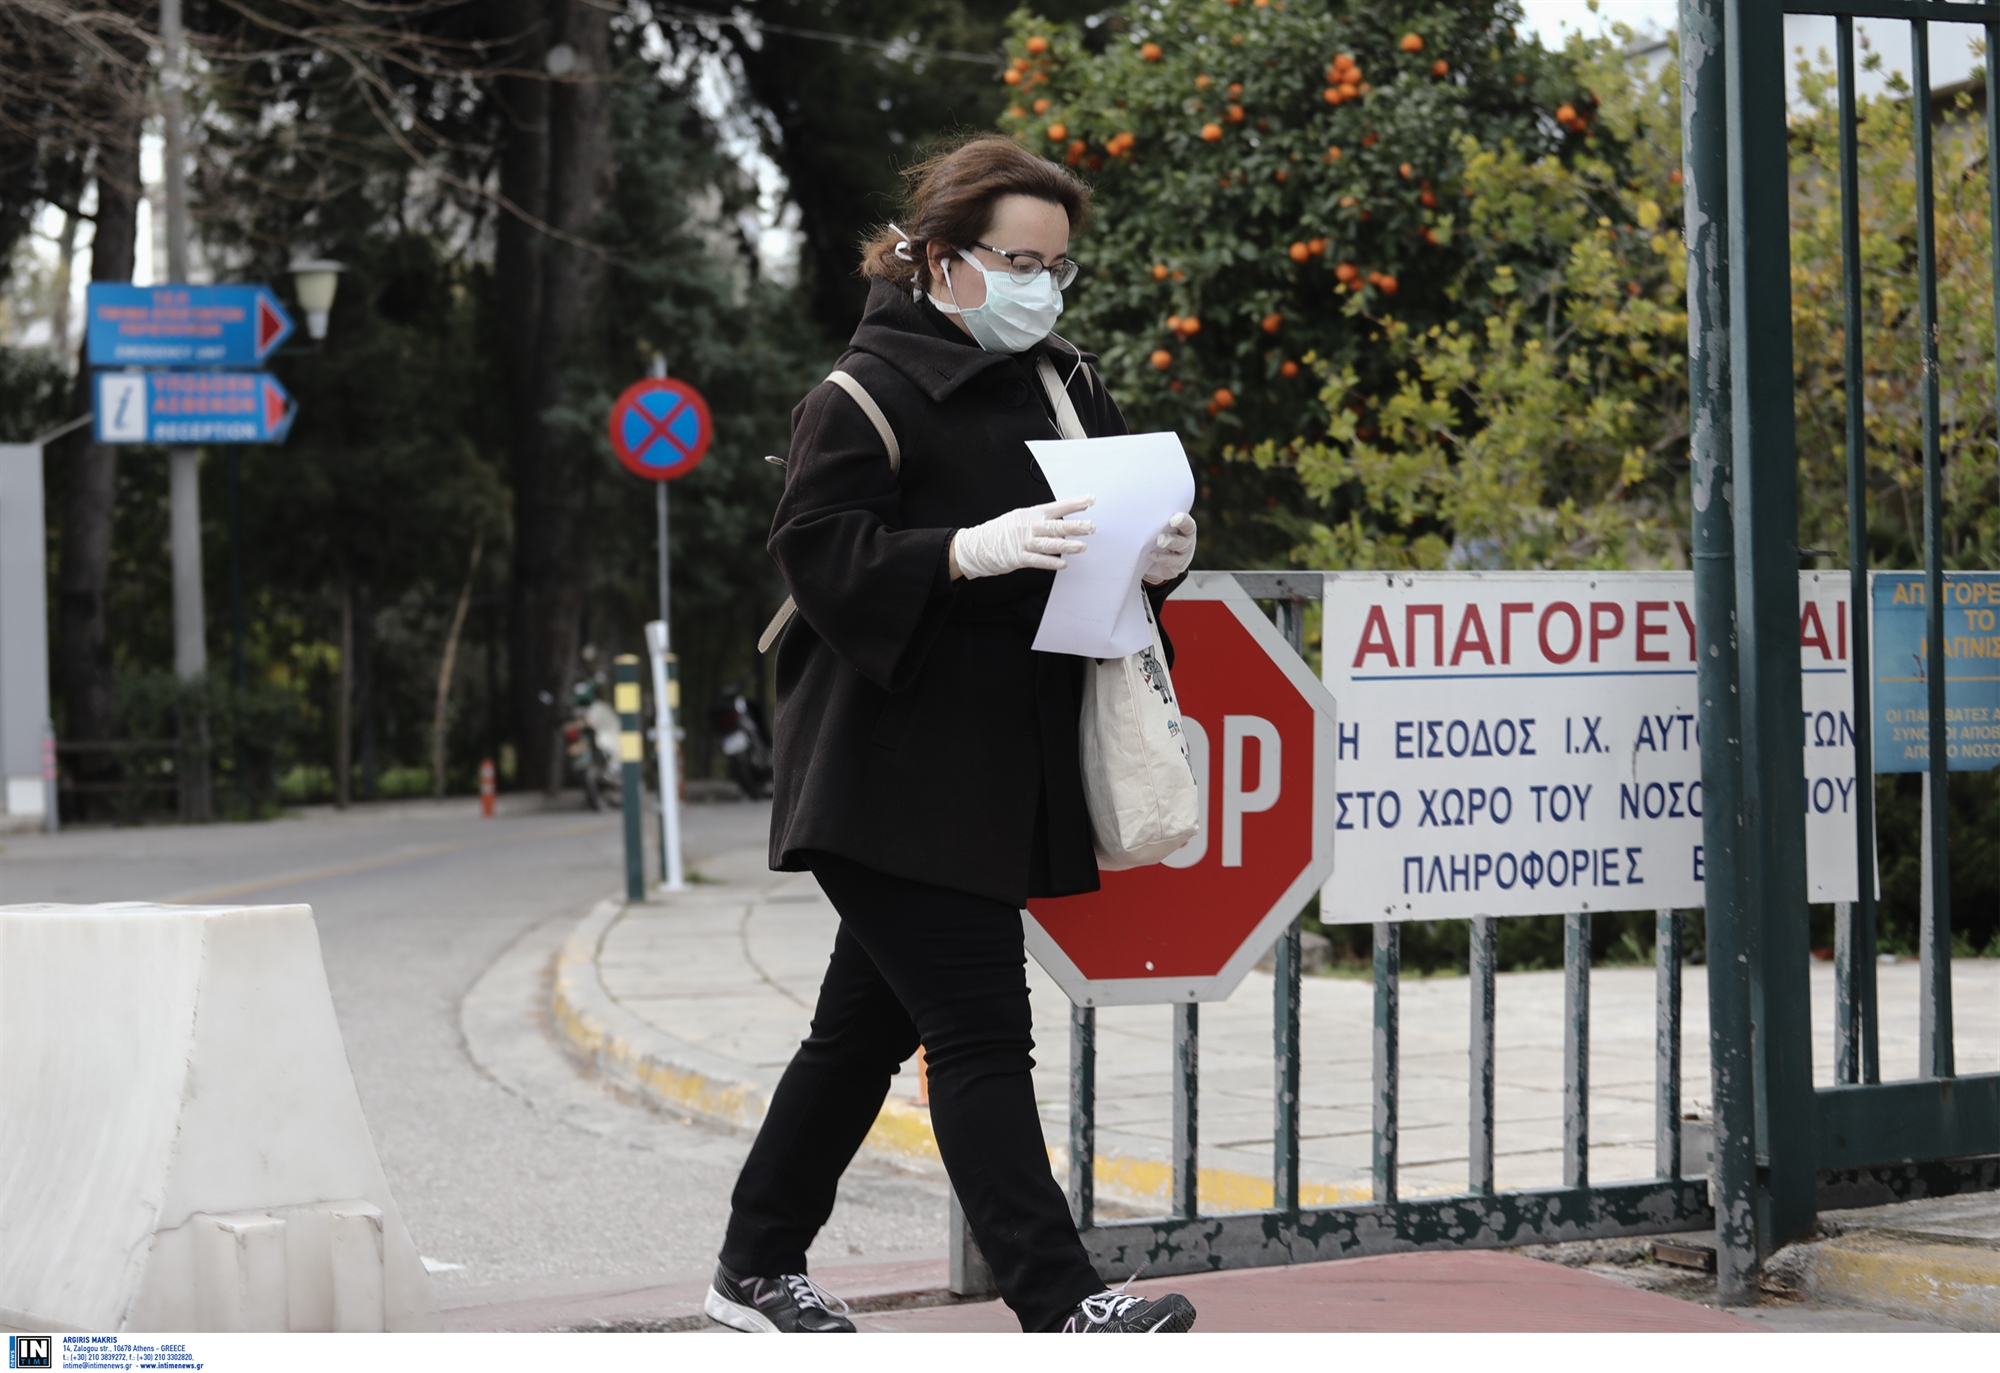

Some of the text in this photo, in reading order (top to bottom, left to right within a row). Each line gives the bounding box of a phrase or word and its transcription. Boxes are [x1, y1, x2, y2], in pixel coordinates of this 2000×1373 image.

[154, 423, 256, 440] RECEPTION
[1892, 582, 2000, 604] ΑΠΓΟΡΕ
[1351, 600, 1847, 669] ΑΠΑΓΟΡΕΥΑΙ
[1964, 609, 1995, 631] ΤΟ
[1906, 708, 1989, 723] ΠΑΒΑΤΕΣ
[1338, 722, 1359, 760] Η
[1395, 718, 1536, 759] ΕΙΣΟΔΟΣ
[1893, 726, 1957, 741] ΣΥΝΟΟΙ
[1159, 715, 1282, 868] OP
[1336, 790, 1401, 829] ΣΤΟ
[1417, 786, 1512, 827] ΧΩΡΟ
[1530, 784, 1593, 823] ΤΟΥ
[1403, 847, 1644, 894] ΠΛΗΡΟΦΟΡΙΕΣ
